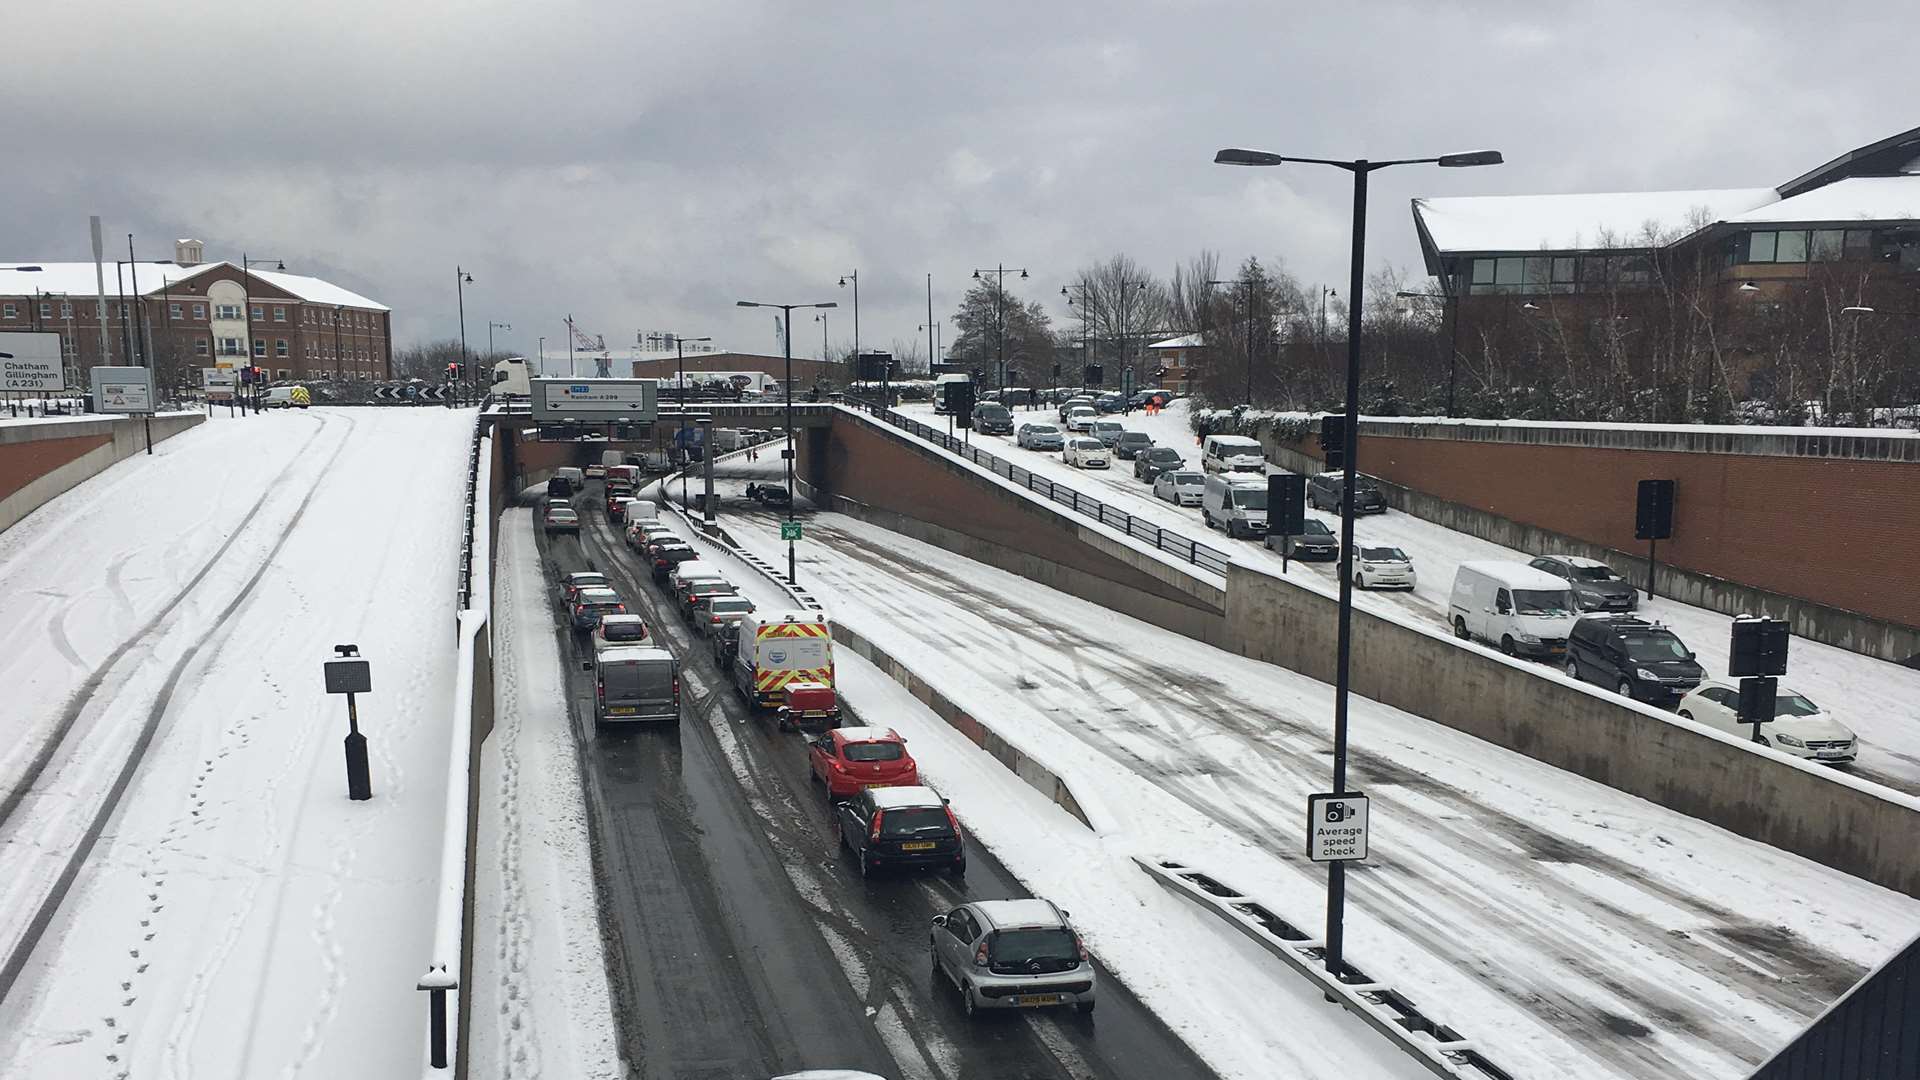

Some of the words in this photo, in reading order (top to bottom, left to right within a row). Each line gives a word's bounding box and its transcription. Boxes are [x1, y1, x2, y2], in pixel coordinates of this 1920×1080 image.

[4, 362, 49, 370] Chatham
[5, 371, 58, 379] Gillingham
[1317, 828, 1362, 836] Average
[1323, 837, 1356, 847] speed
[1323, 847, 1355, 856] check
